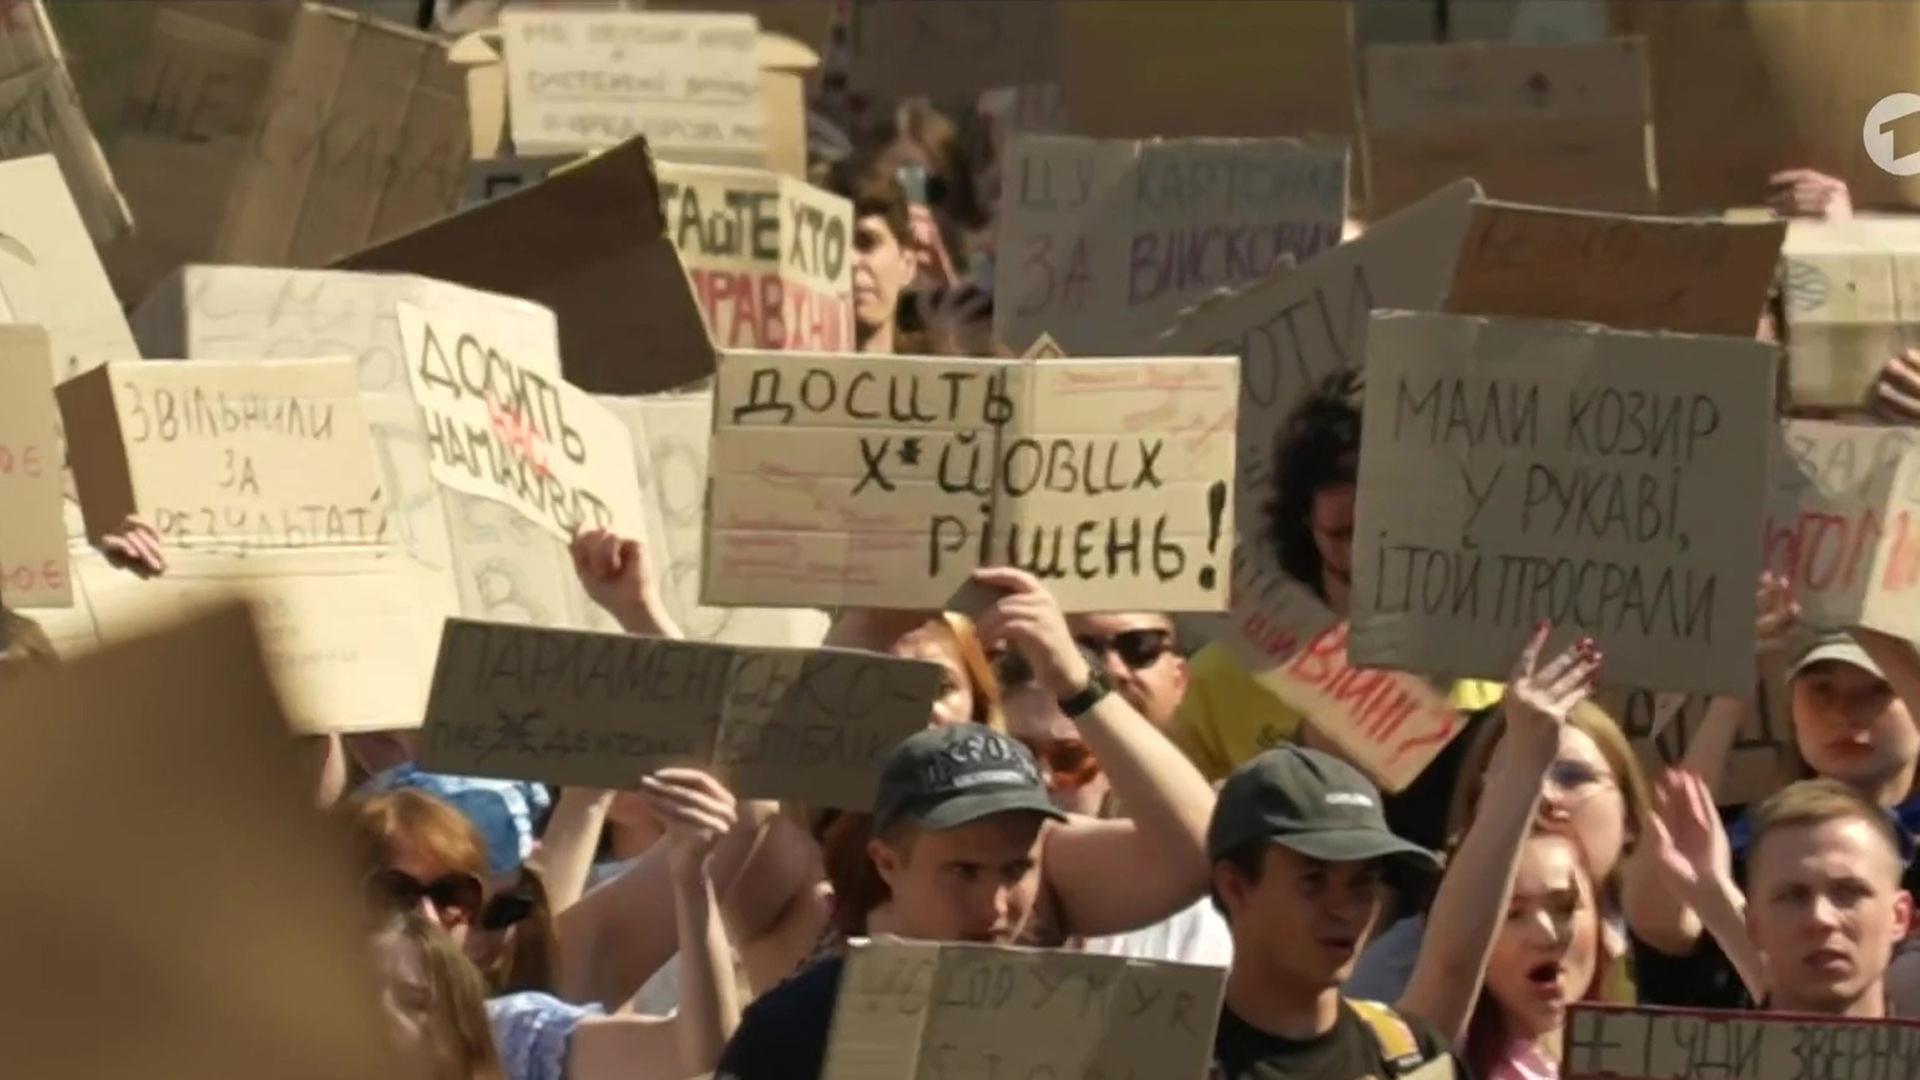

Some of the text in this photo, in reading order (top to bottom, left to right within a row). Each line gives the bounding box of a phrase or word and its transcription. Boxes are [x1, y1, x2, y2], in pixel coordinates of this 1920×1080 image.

[788, 198, 846, 282] ХТО
[122, 380, 334, 443] ЗВІЛЬНИЛИ
[419, 320, 586, 466] ДОСИТЬ
[733, 366, 1014, 425] ДОСИТЬ
[1394, 377, 1721, 460] МАЛИ КОЗИР
[218, 448, 260, 496] ЗА
[1460, 462, 1505, 532] У
[1520, 462, 1692, 552] РУКАВІ,
